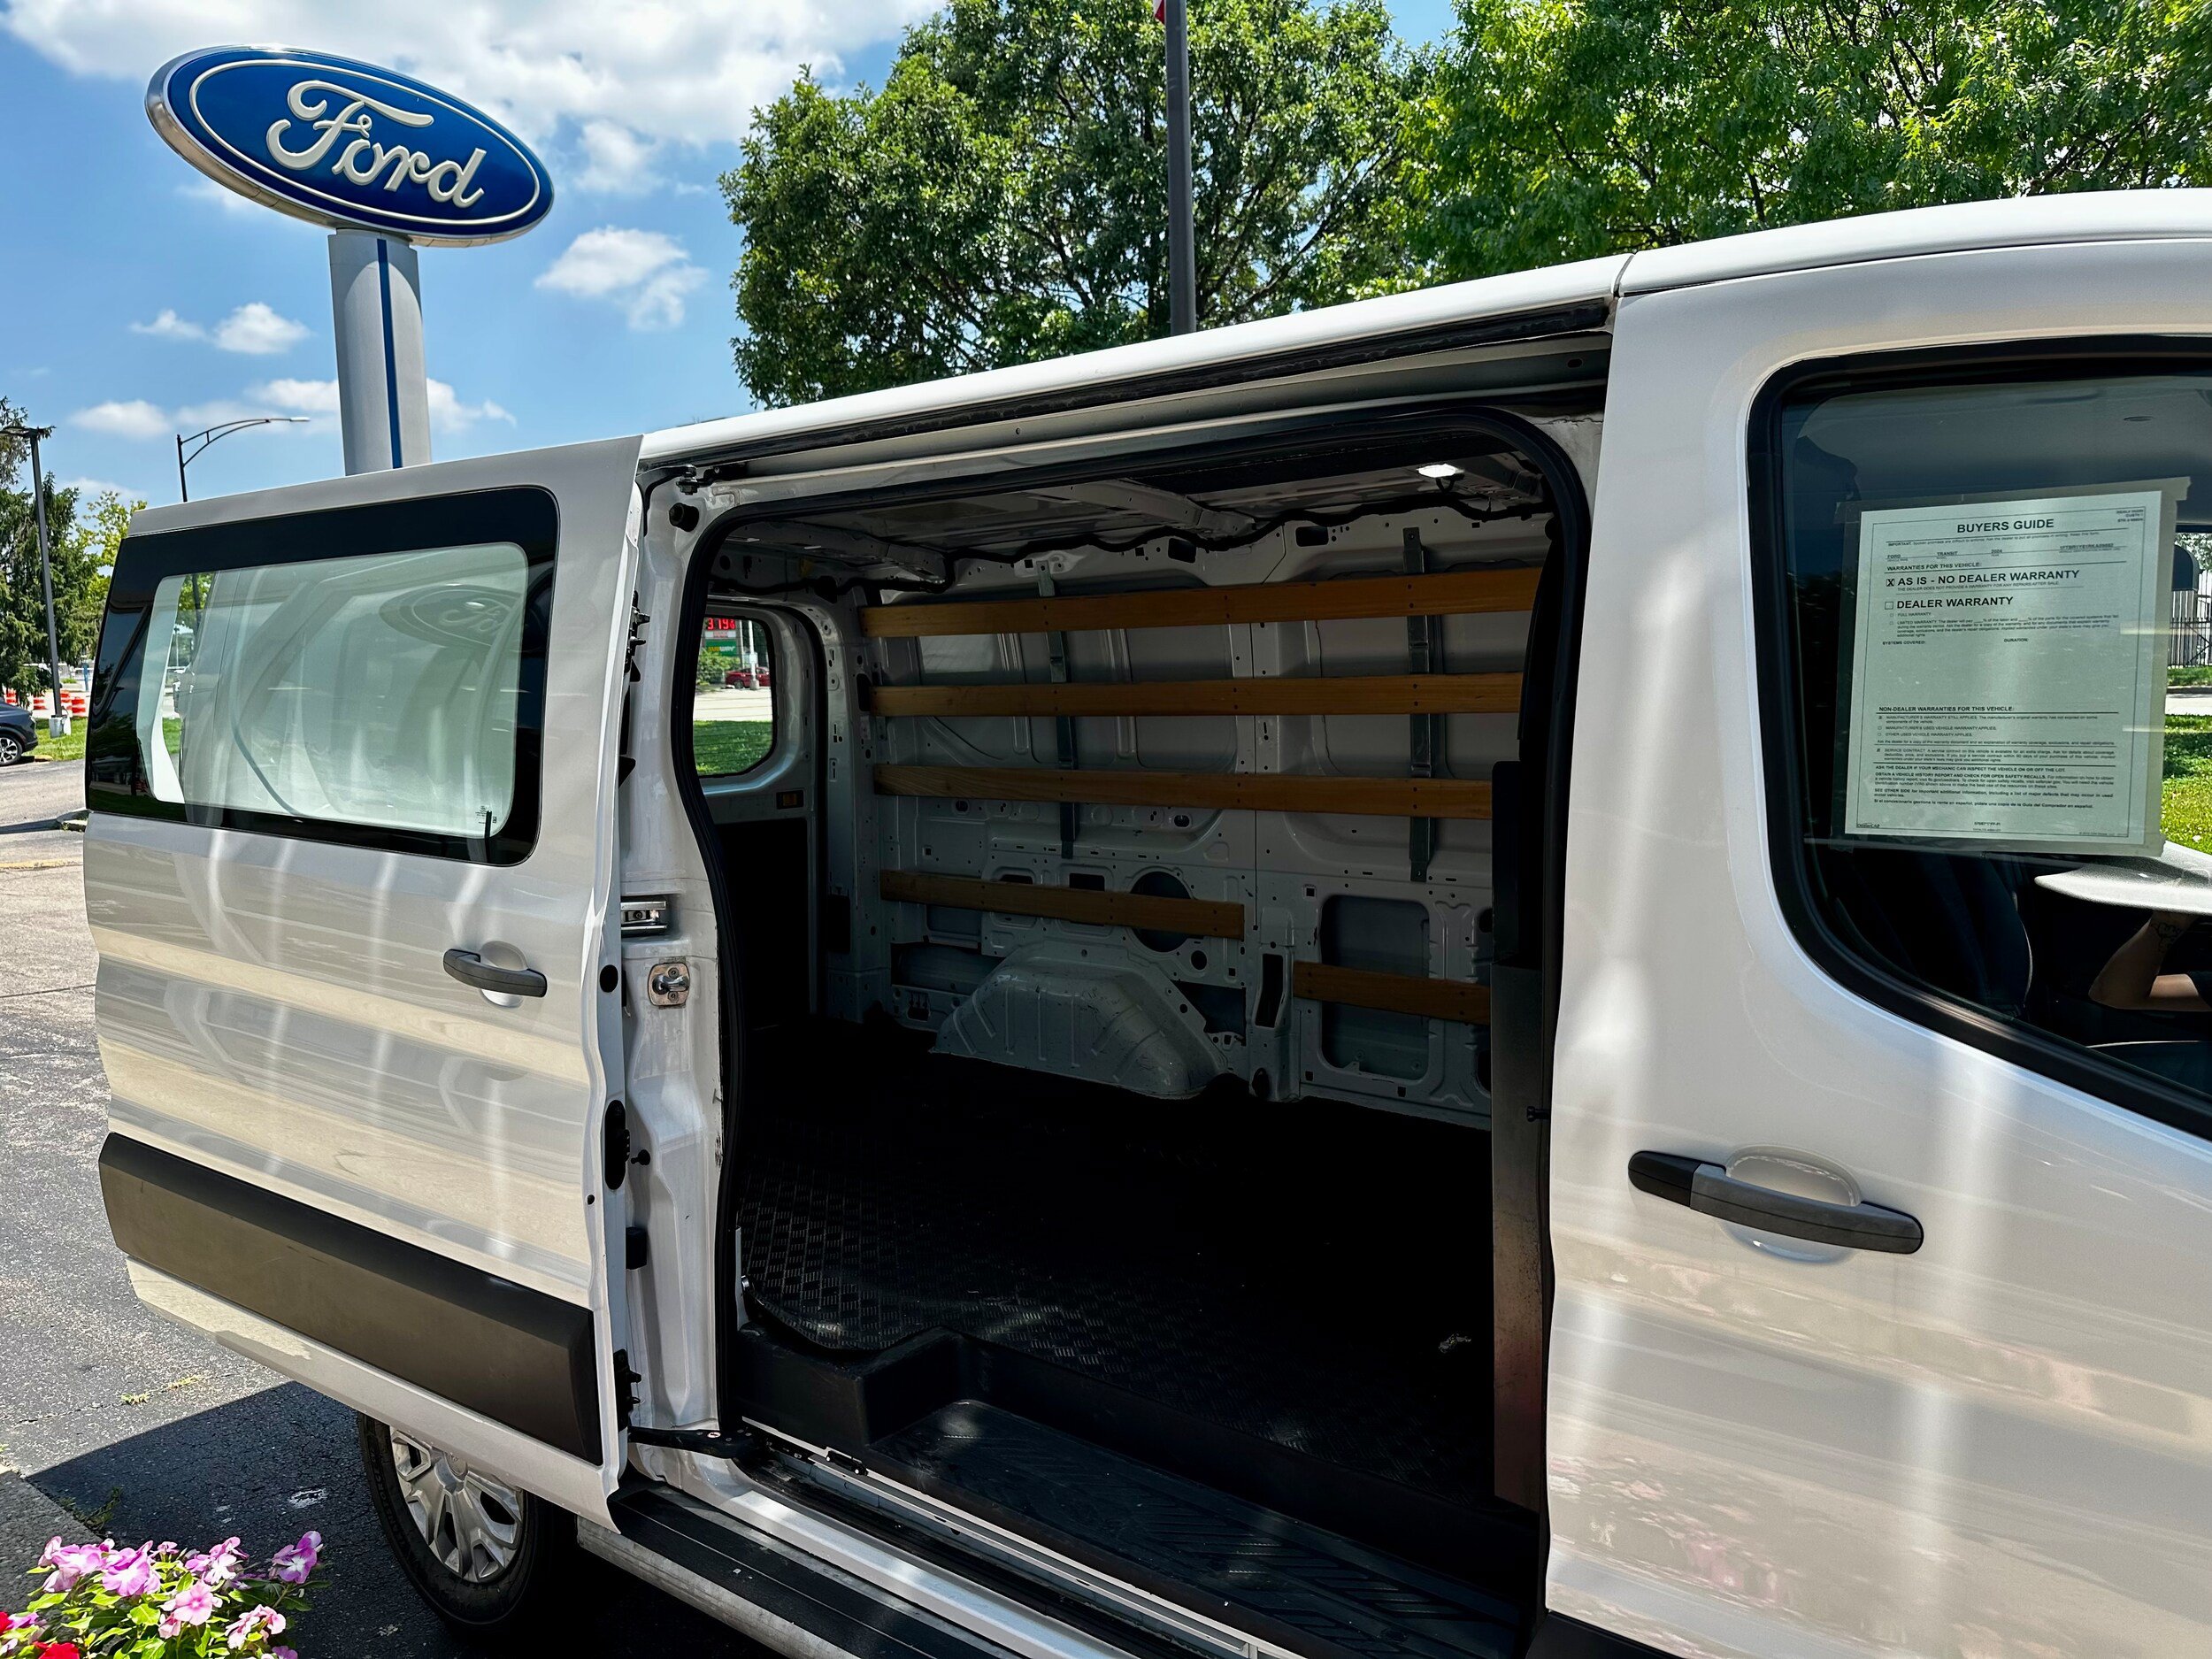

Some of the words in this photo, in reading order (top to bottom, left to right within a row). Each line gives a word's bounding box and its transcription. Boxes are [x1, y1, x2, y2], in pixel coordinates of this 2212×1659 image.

[266, 80, 486, 208] Ford
[1957, 521, 2009, 533] BUYERS
[2013, 518, 2055, 530] GUIDE
[1959, 573, 2006, 583] DEALER
[2009, 571, 2079, 581] WARRANTY
[1897, 599, 1943, 609] DEALER
[1946, 597, 2013, 607] WARRANTY
